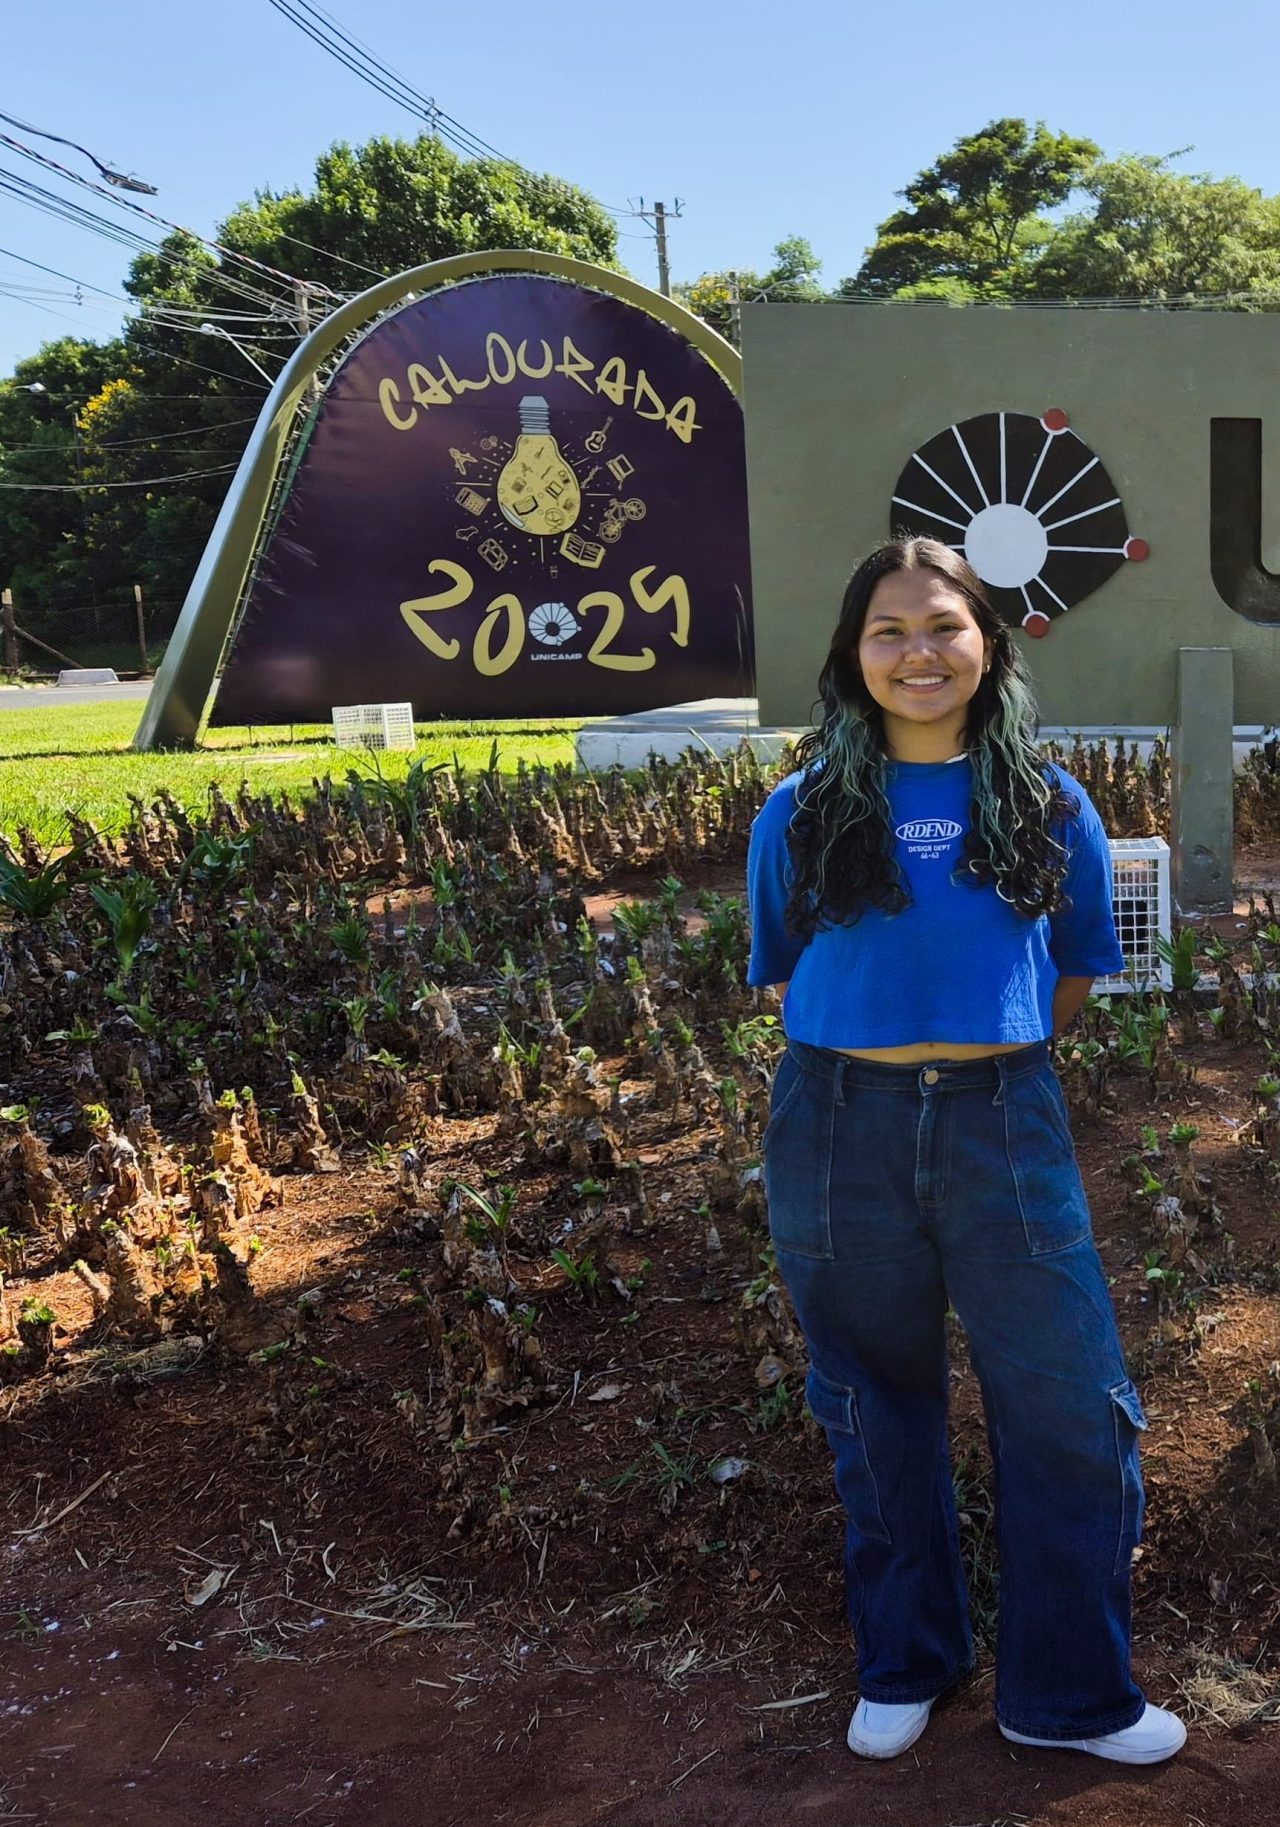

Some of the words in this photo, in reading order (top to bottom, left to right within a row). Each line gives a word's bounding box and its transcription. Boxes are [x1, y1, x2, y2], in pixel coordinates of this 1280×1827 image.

[378, 332, 703, 444] CALOURADA
[400, 558, 690, 676] 2025
[531, 653, 582, 661] UNICAMP
[908, 845, 932, 853] DESIGN
